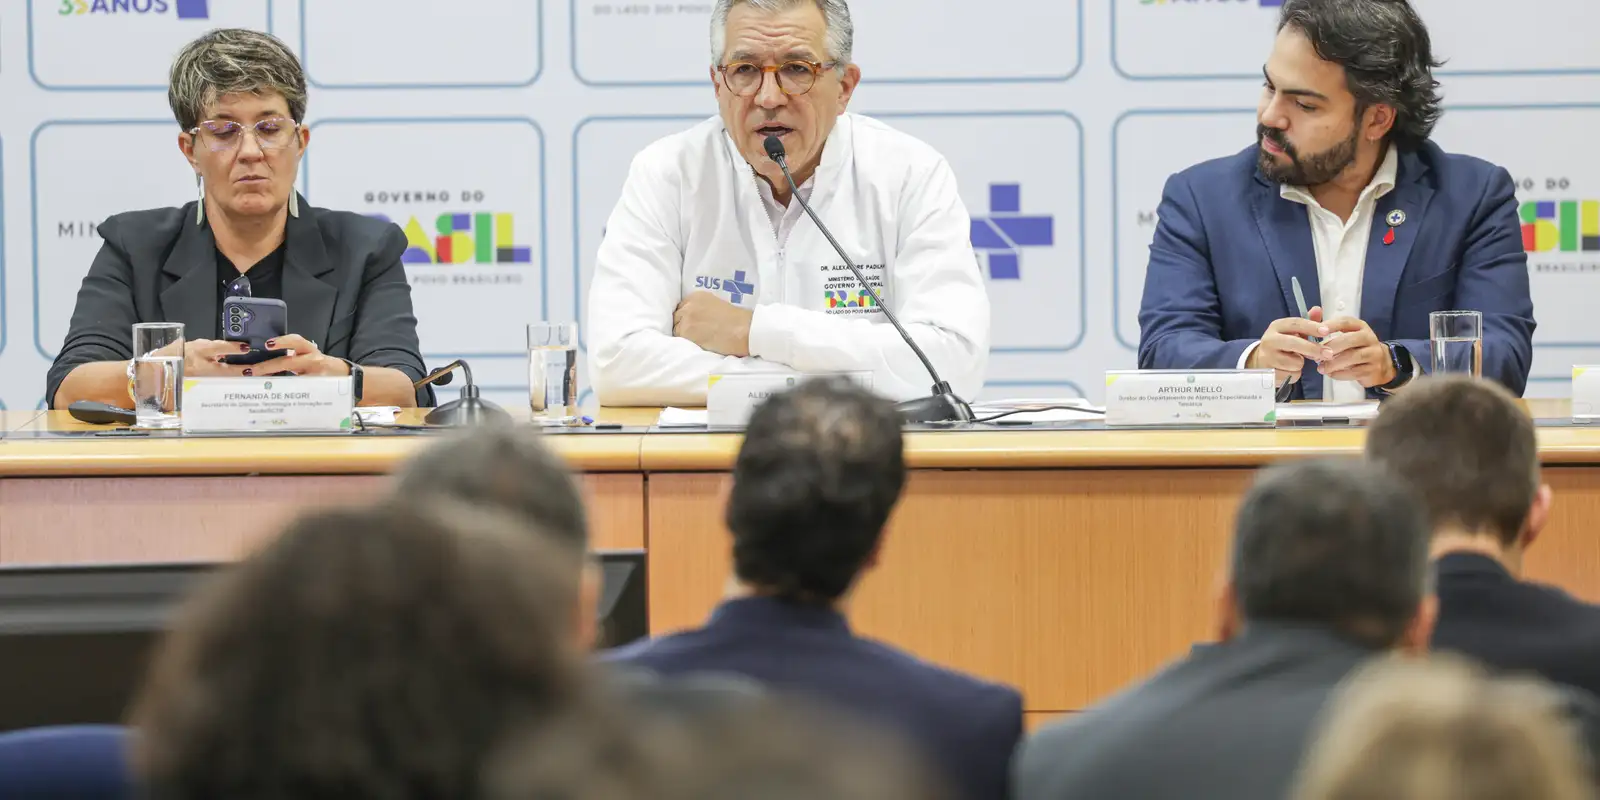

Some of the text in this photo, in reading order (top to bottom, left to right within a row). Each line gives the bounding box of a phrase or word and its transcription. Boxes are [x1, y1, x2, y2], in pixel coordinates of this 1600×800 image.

[1545, 178, 1570, 190] DO
[364, 191, 485, 203] GOVERNO DO
[695, 275, 721, 290] SUS
